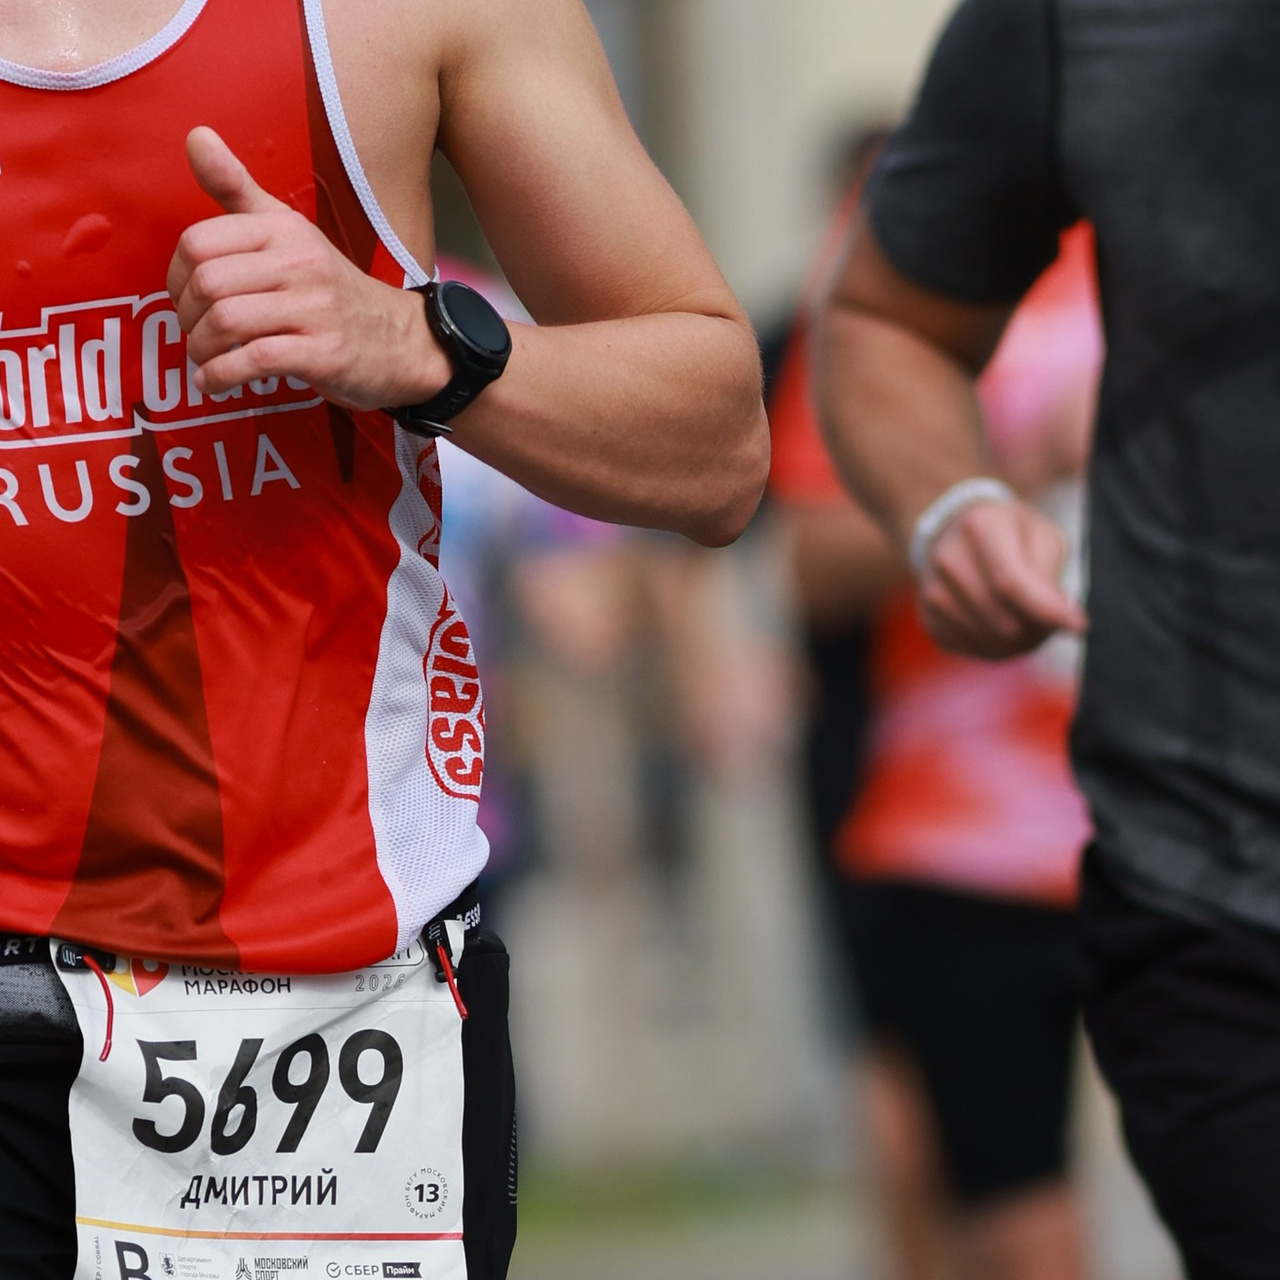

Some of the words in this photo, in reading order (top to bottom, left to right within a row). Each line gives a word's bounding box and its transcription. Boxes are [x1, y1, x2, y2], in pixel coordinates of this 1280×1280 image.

[183, 977, 292, 996] МАРАФОН
[131, 1028, 405, 1157] 5699
[179, 1167, 339, 1210] ДМИТРИЙ
[405, 1172, 417, 1191] БЕГУ
[414, 1183, 440, 1203] 13
[420, 1167, 449, 1213] МОСКОВСКИЙ
[404, 1194, 436, 1220] МАРАФОН
[94, 1235, 102, 1265] CORRAL
[254, 1255, 309, 1270] МОСКОВСКИЙ
[344, 1264, 380, 1277] СБЕР
[385, 1264, 415, 1276] Прайм
